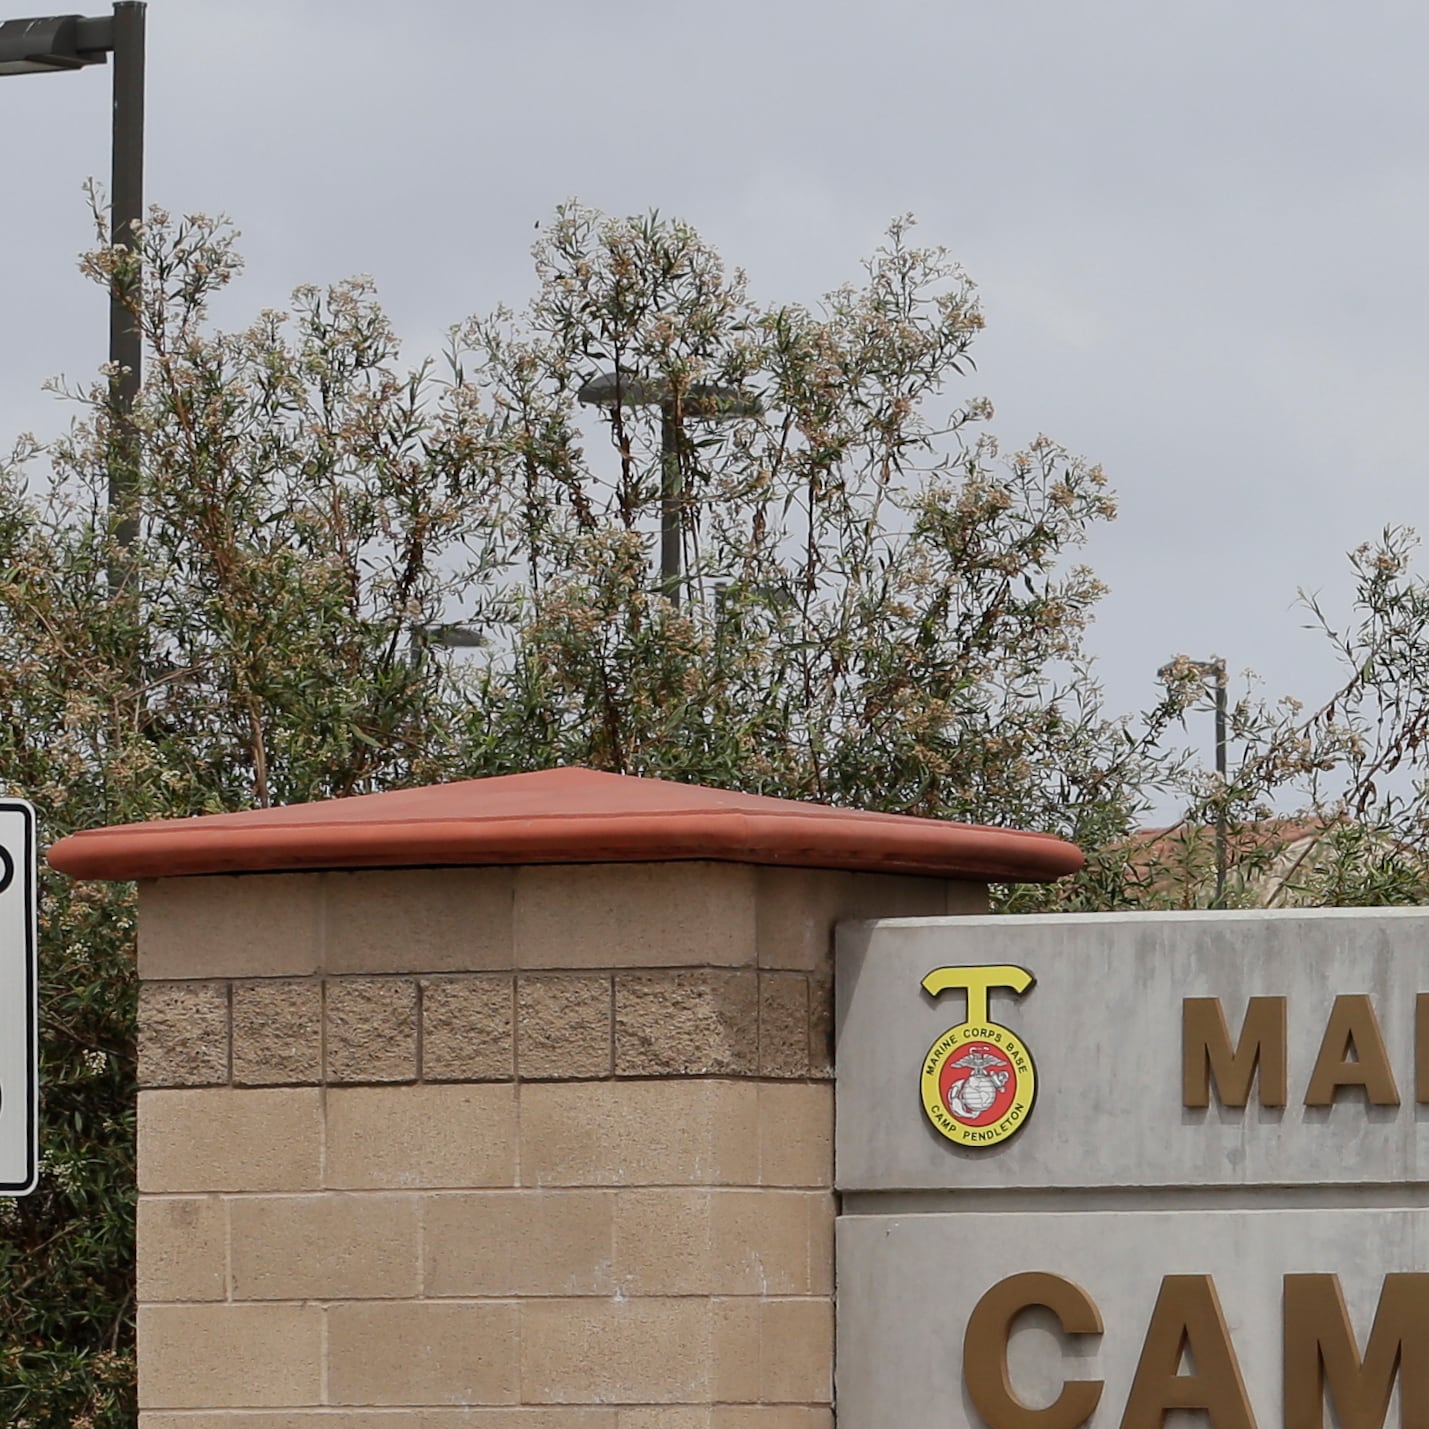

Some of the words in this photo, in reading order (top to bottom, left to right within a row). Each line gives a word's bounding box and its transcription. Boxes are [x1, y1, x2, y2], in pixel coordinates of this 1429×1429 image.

[926, 1035, 957, 1076] MARINE
[963, 1028, 1002, 1043] CORPS
[1007, 1043, 1028, 1073] BASE
[931, 1105, 956, 1132] CAMP
[963, 1103, 1024, 1141] PENDLETON
